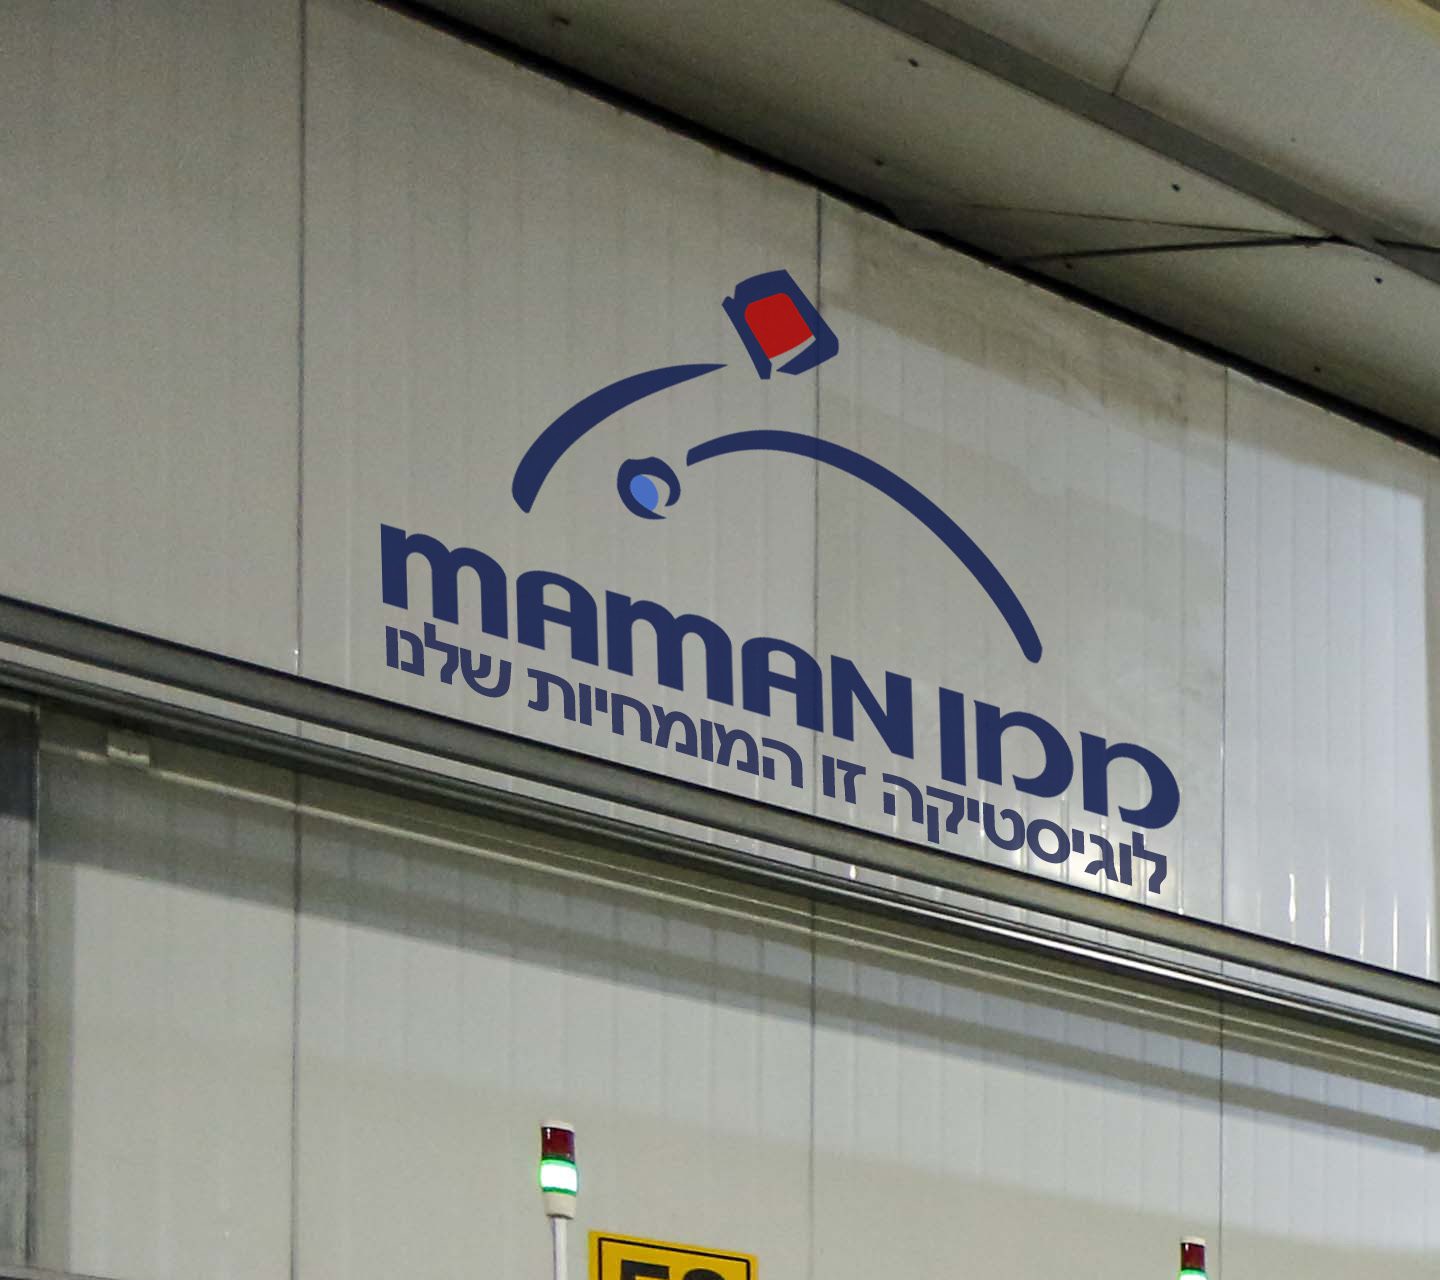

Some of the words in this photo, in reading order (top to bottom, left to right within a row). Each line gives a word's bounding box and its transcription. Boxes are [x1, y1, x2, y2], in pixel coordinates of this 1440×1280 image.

[380, 523, 914, 759] MAMAN
[385, 623, 512, 698] שלנו
[528, 669, 803, 788] המומחיות
[823, 754, 865, 804] זו
[941, 687, 1180, 830] ממן
[883, 775, 1168, 894] לוגיסטיקה
